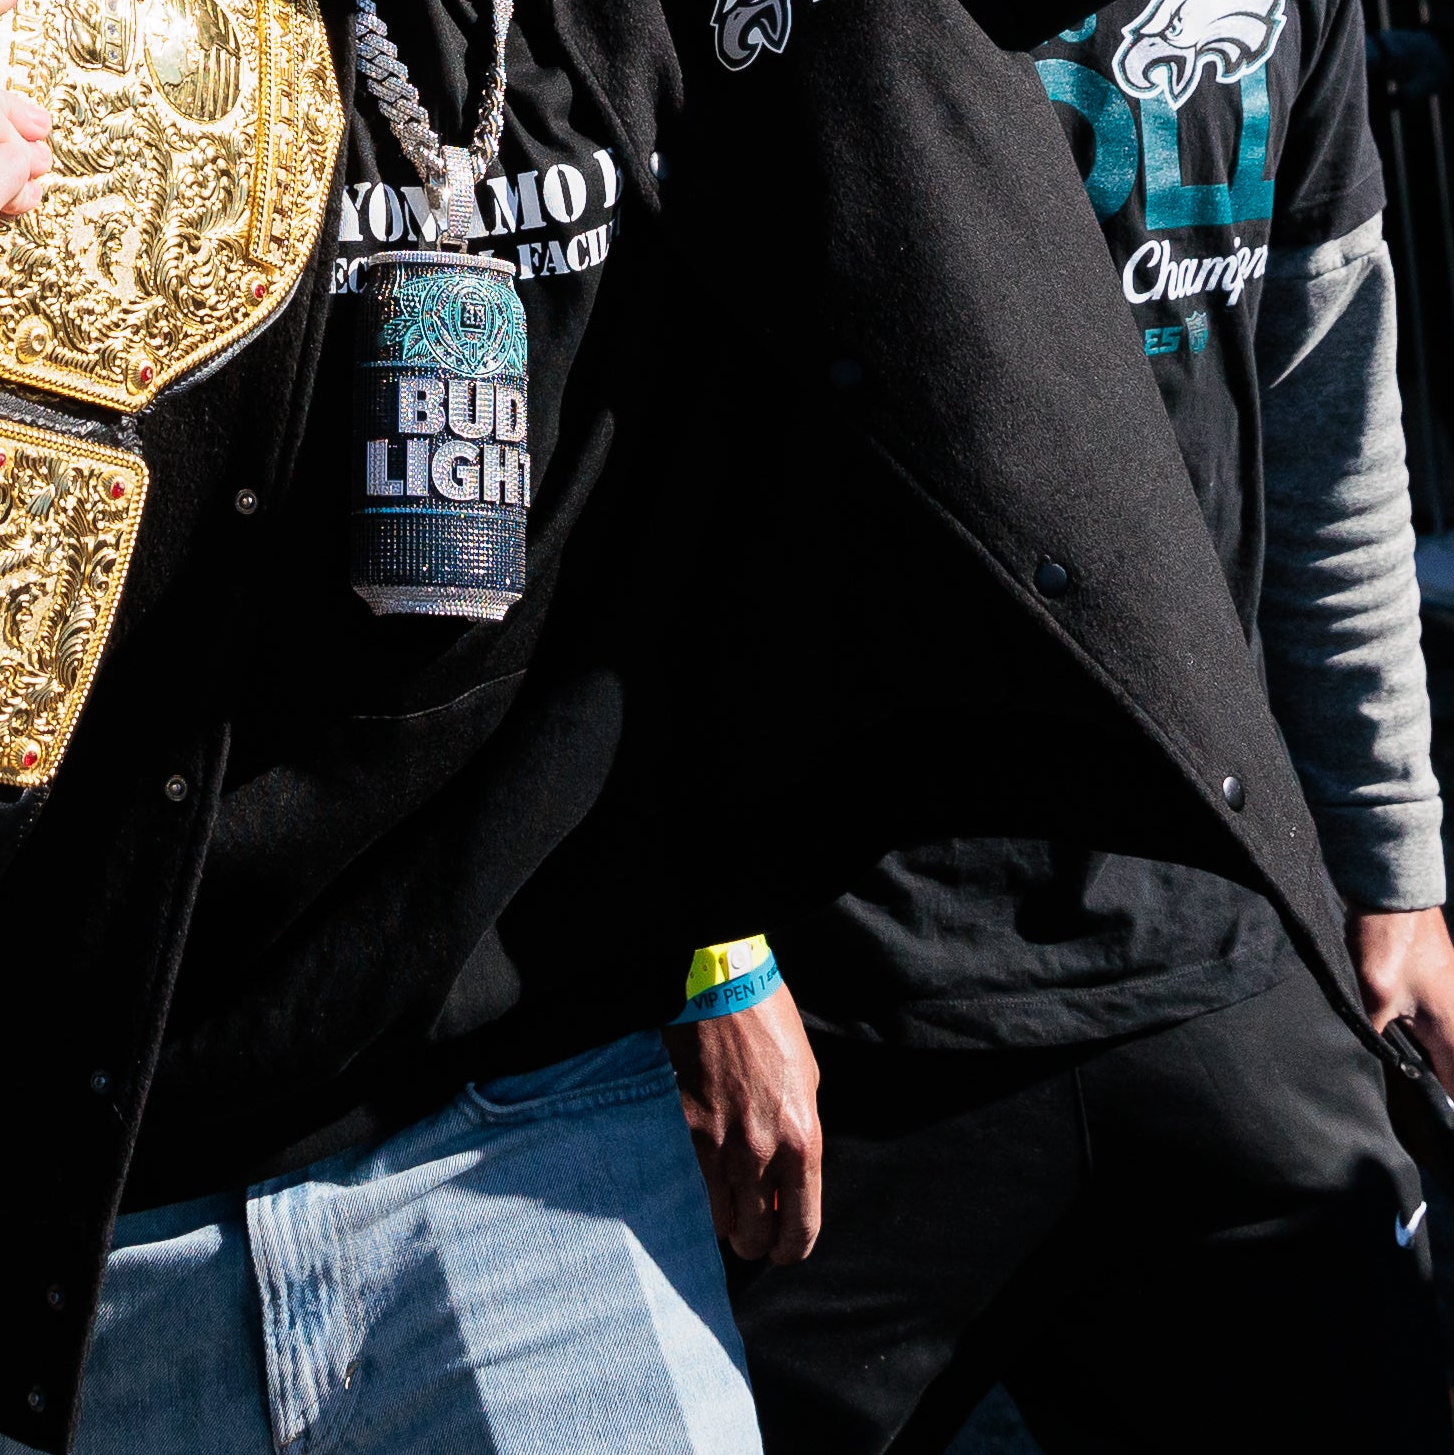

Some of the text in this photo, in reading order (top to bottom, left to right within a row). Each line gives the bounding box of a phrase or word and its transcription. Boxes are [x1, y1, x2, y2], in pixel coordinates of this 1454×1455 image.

[398, 377, 527, 443] BUD
[692, 991, 718, 1011] VIP
[723, 981, 755, 1005] PEN
